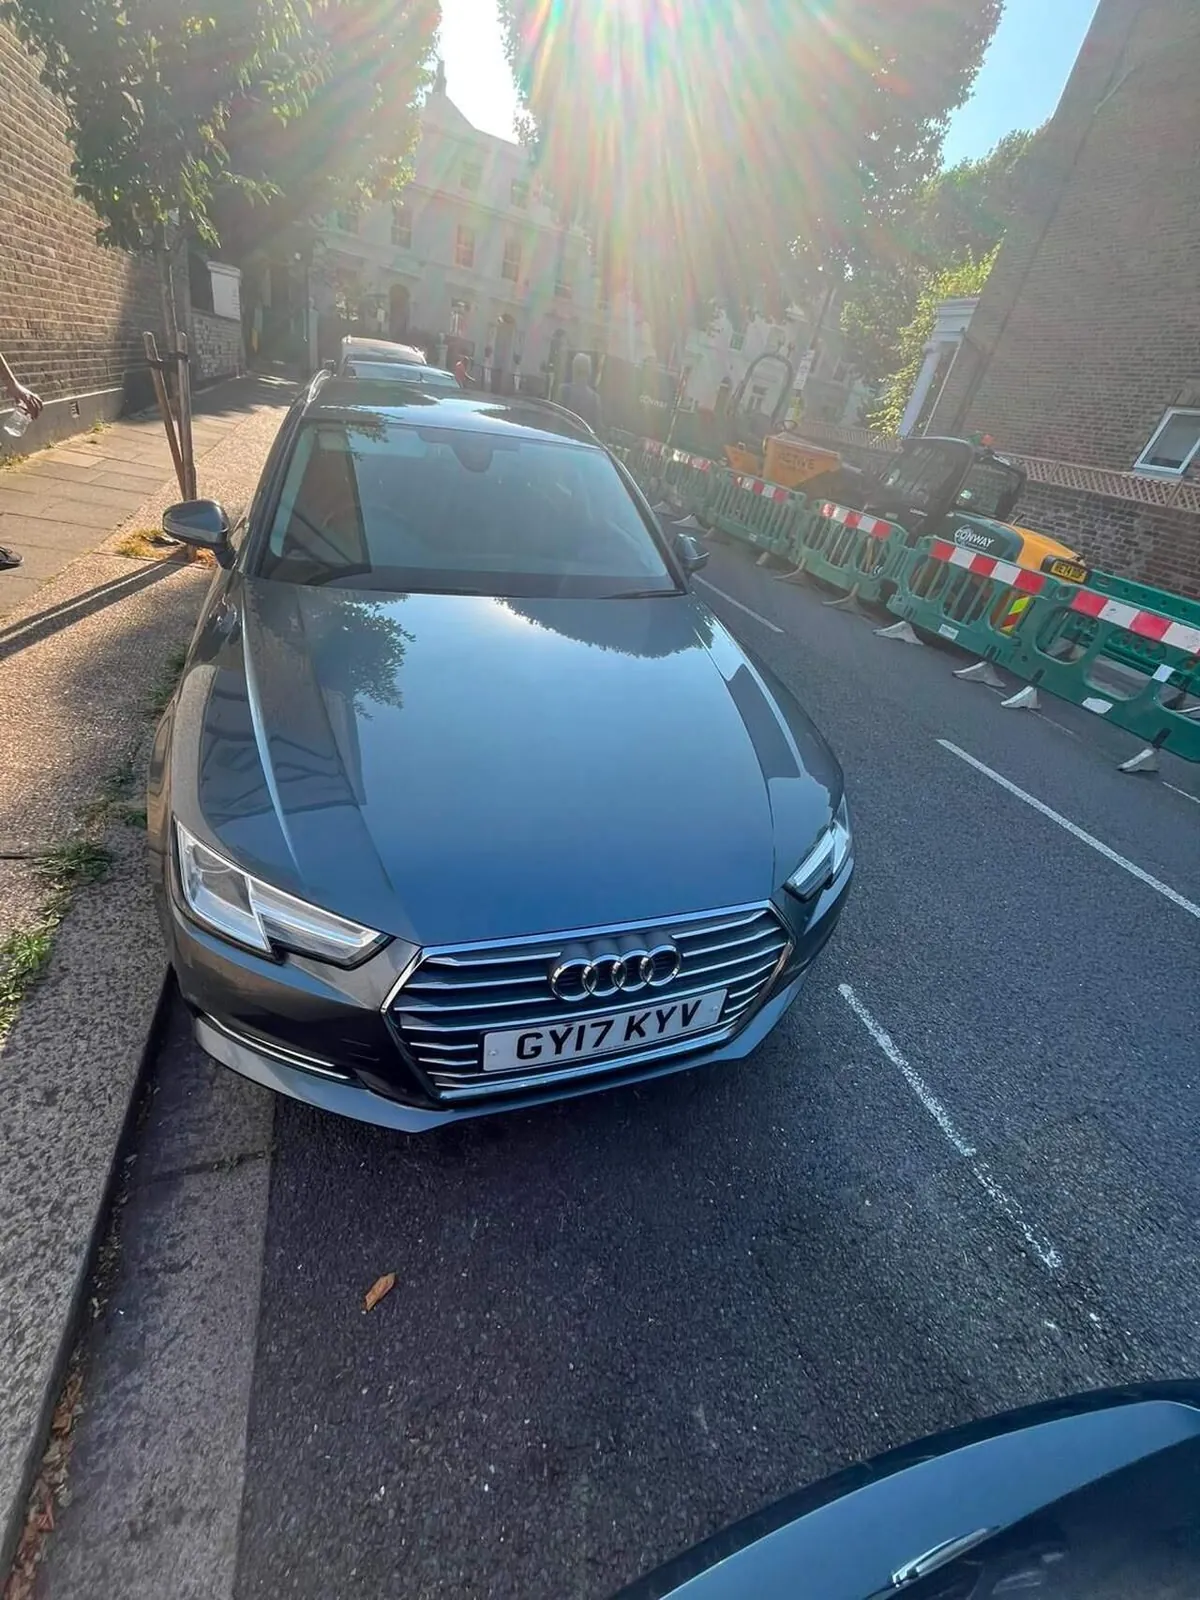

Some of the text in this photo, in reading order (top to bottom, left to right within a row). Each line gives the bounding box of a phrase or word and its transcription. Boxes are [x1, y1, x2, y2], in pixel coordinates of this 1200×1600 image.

[954, 529, 995, 548] CONWAY
[516, 999, 702, 1060] GY17 KYV
